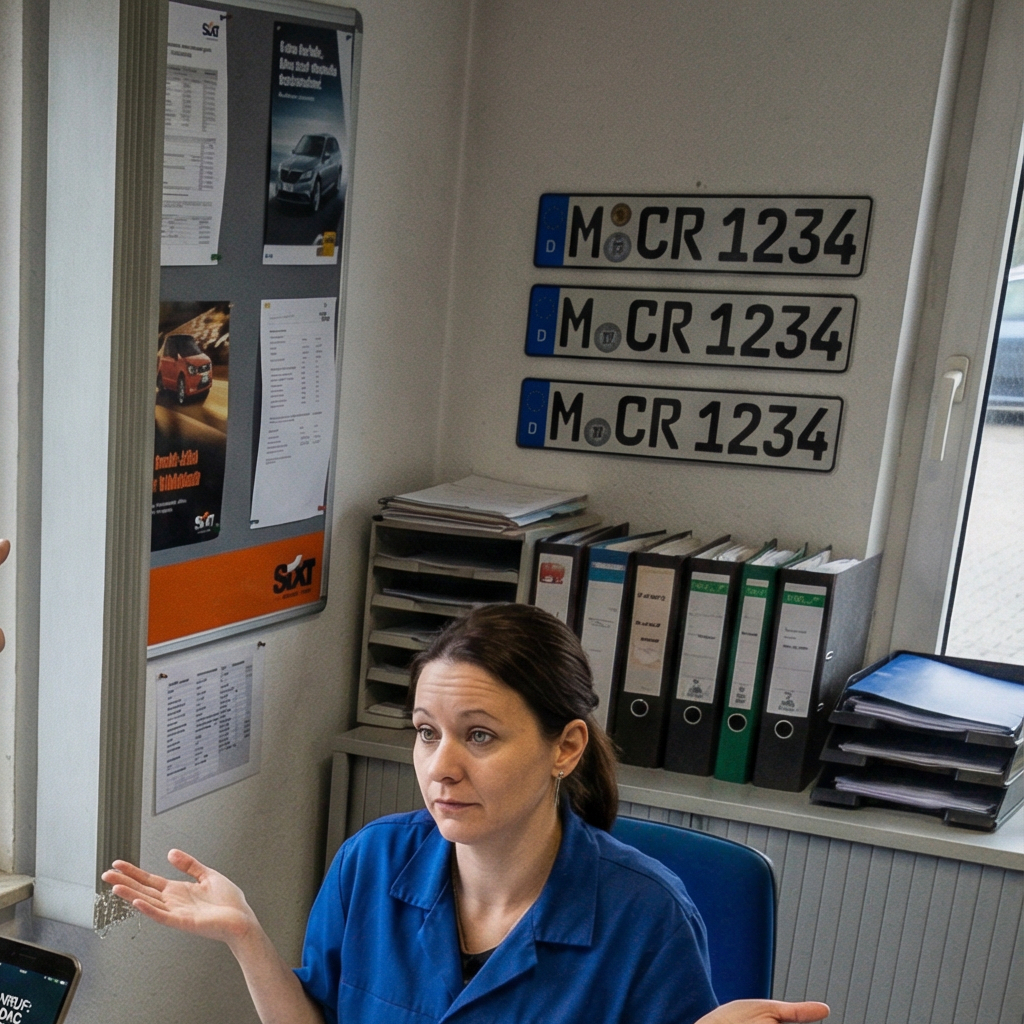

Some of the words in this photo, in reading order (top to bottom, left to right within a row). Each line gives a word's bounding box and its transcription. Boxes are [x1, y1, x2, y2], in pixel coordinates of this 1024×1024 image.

[568, 205, 604, 258] M
[636, 206, 705, 261] CR
[718, 207, 857, 265] 1234
[559, 297, 594, 349] M
[626, 299, 693, 354] CR
[705, 302, 843, 361] 1234
[549, 391, 584, 442] M
[615, 395, 682, 450] CR
[694, 400, 828, 461] 1234
